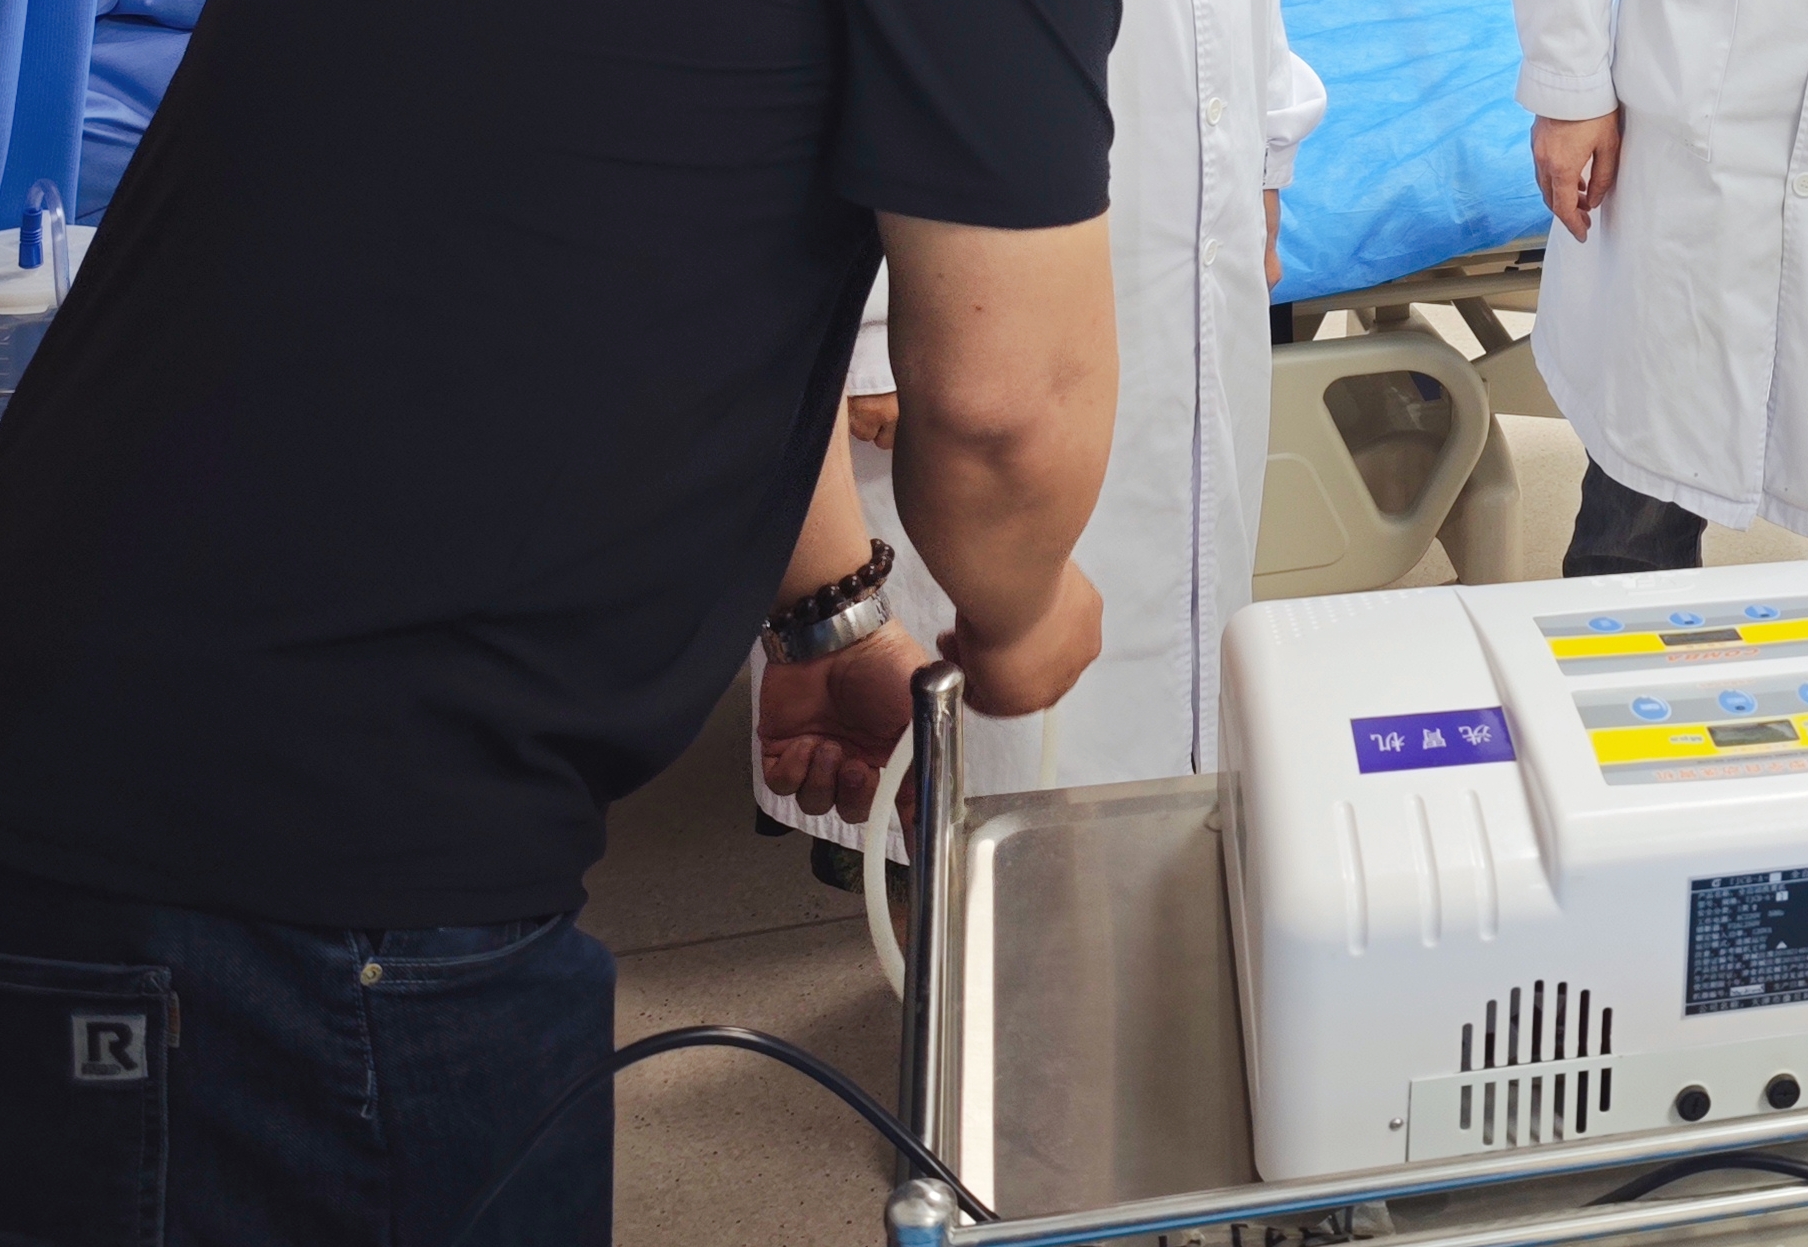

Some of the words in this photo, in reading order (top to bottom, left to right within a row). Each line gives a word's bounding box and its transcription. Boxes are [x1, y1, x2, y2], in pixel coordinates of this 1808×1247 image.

[1666, 646, 1761, 662] COMBA
[1369, 723, 1494, 753] 洗胃机
